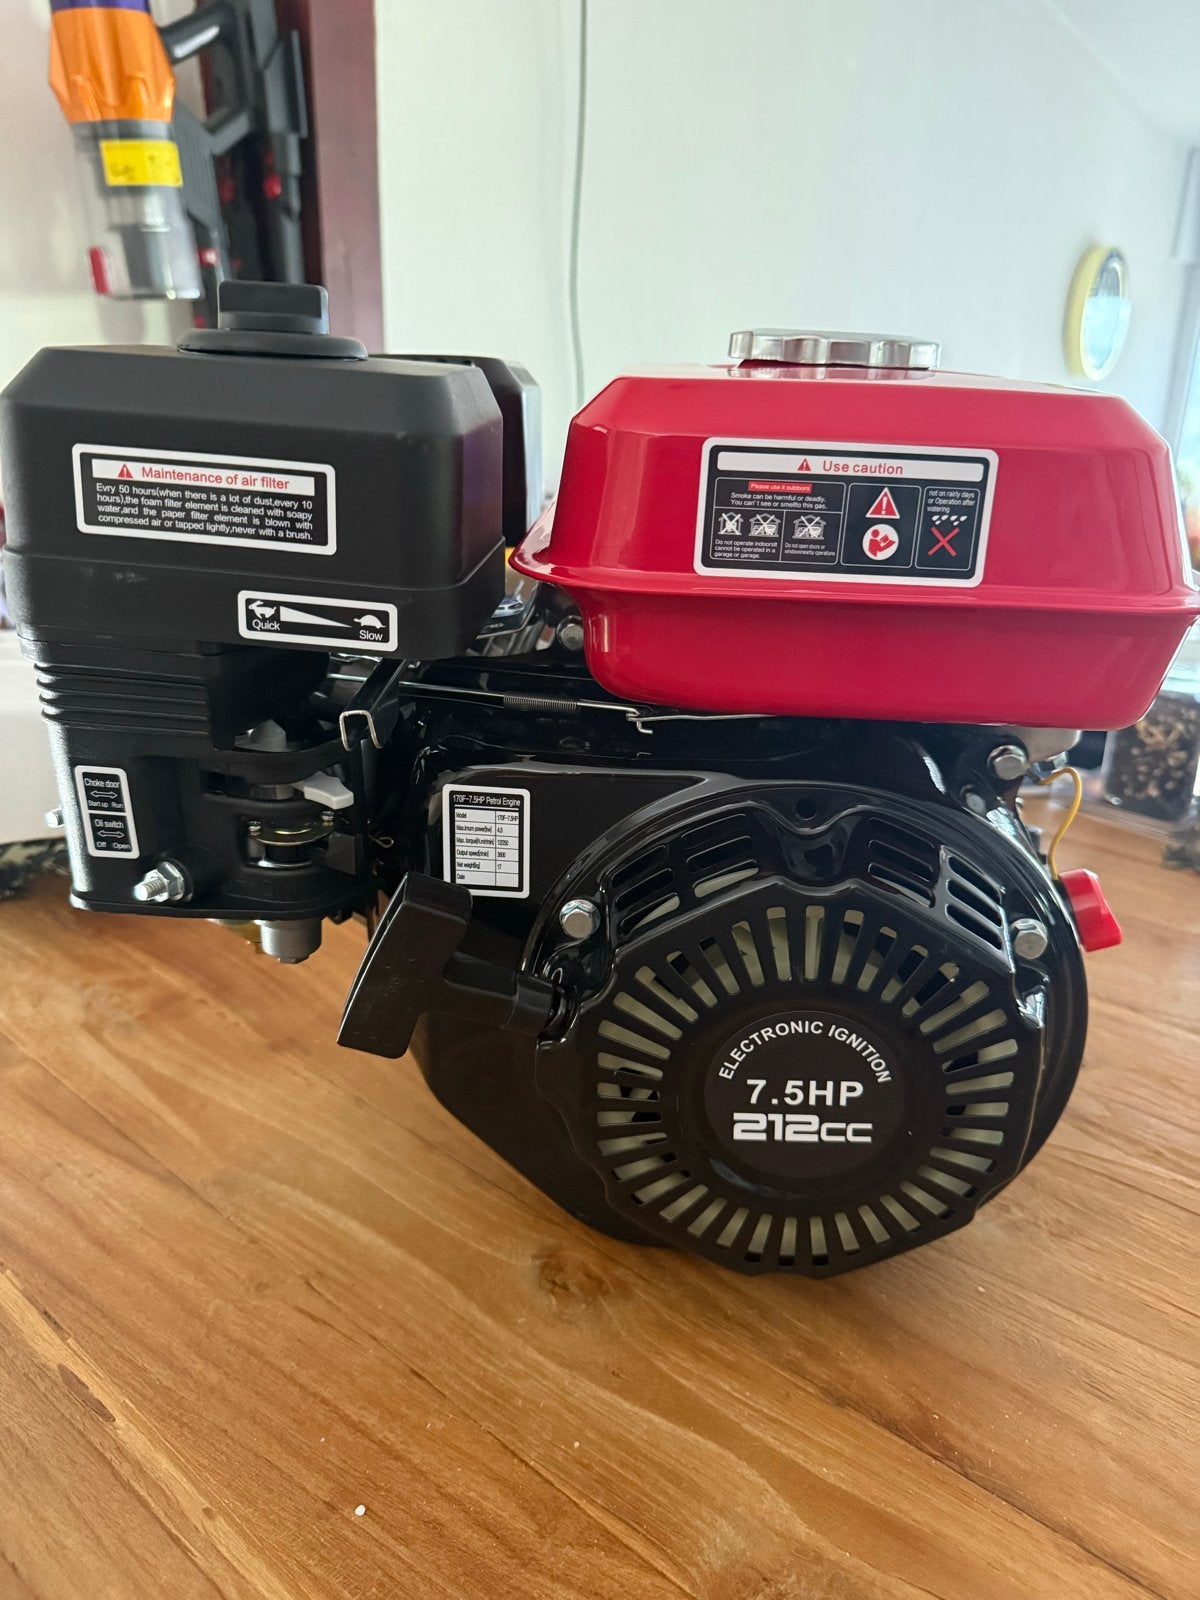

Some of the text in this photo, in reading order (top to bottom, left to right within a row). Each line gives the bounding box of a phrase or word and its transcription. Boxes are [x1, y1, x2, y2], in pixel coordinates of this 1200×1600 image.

[142, 466, 290, 489] Maintenance of air filter
[823, 460, 903, 475] Use caution
[96, 483, 115, 494] Evry
[119, 485, 129, 493] 50
[132, 486, 182, 498] hours(when
[185, 491, 207, 500] there
[210, 492, 217, 500] is
[229, 494, 240, 503] lot
[242, 495, 252, 504] of
[254, 497, 298, 509] dust,every
[302, 501, 312, 509] 10
[97, 505, 312, 530] water,and the paper filter element is blown with
[141, 497, 162, 506] foam
[164, 499, 183, 508] filter
[185, 501, 218, 511] element
[222, 503, 228, 512] is
[231, 505, 264, 515] cleaned
[267, 508, 284, 517] with
[287, 510, 312, 521] soapy
[98, 514, 149, 525] compressed
[151, 518, 161, 526] air
[176, 520, 204, 531] tapped
[258, 528, 275, 537] with
[286, 530, 312, 540] brush.
[252, 619, 280, 631] Quick
[359, 630, 383, 641] Slow
[85, 778, 120, 788] Choke door
[486, 796, 502, 804] Petrol
[503, 798, 520, 807] Engine
[719, 1020, 892, 1084] ELECTRONIC IGNITION
[747, 1079, 864, 1106] 7.5HP
[733, 1112, 873, 1143] 212cc
